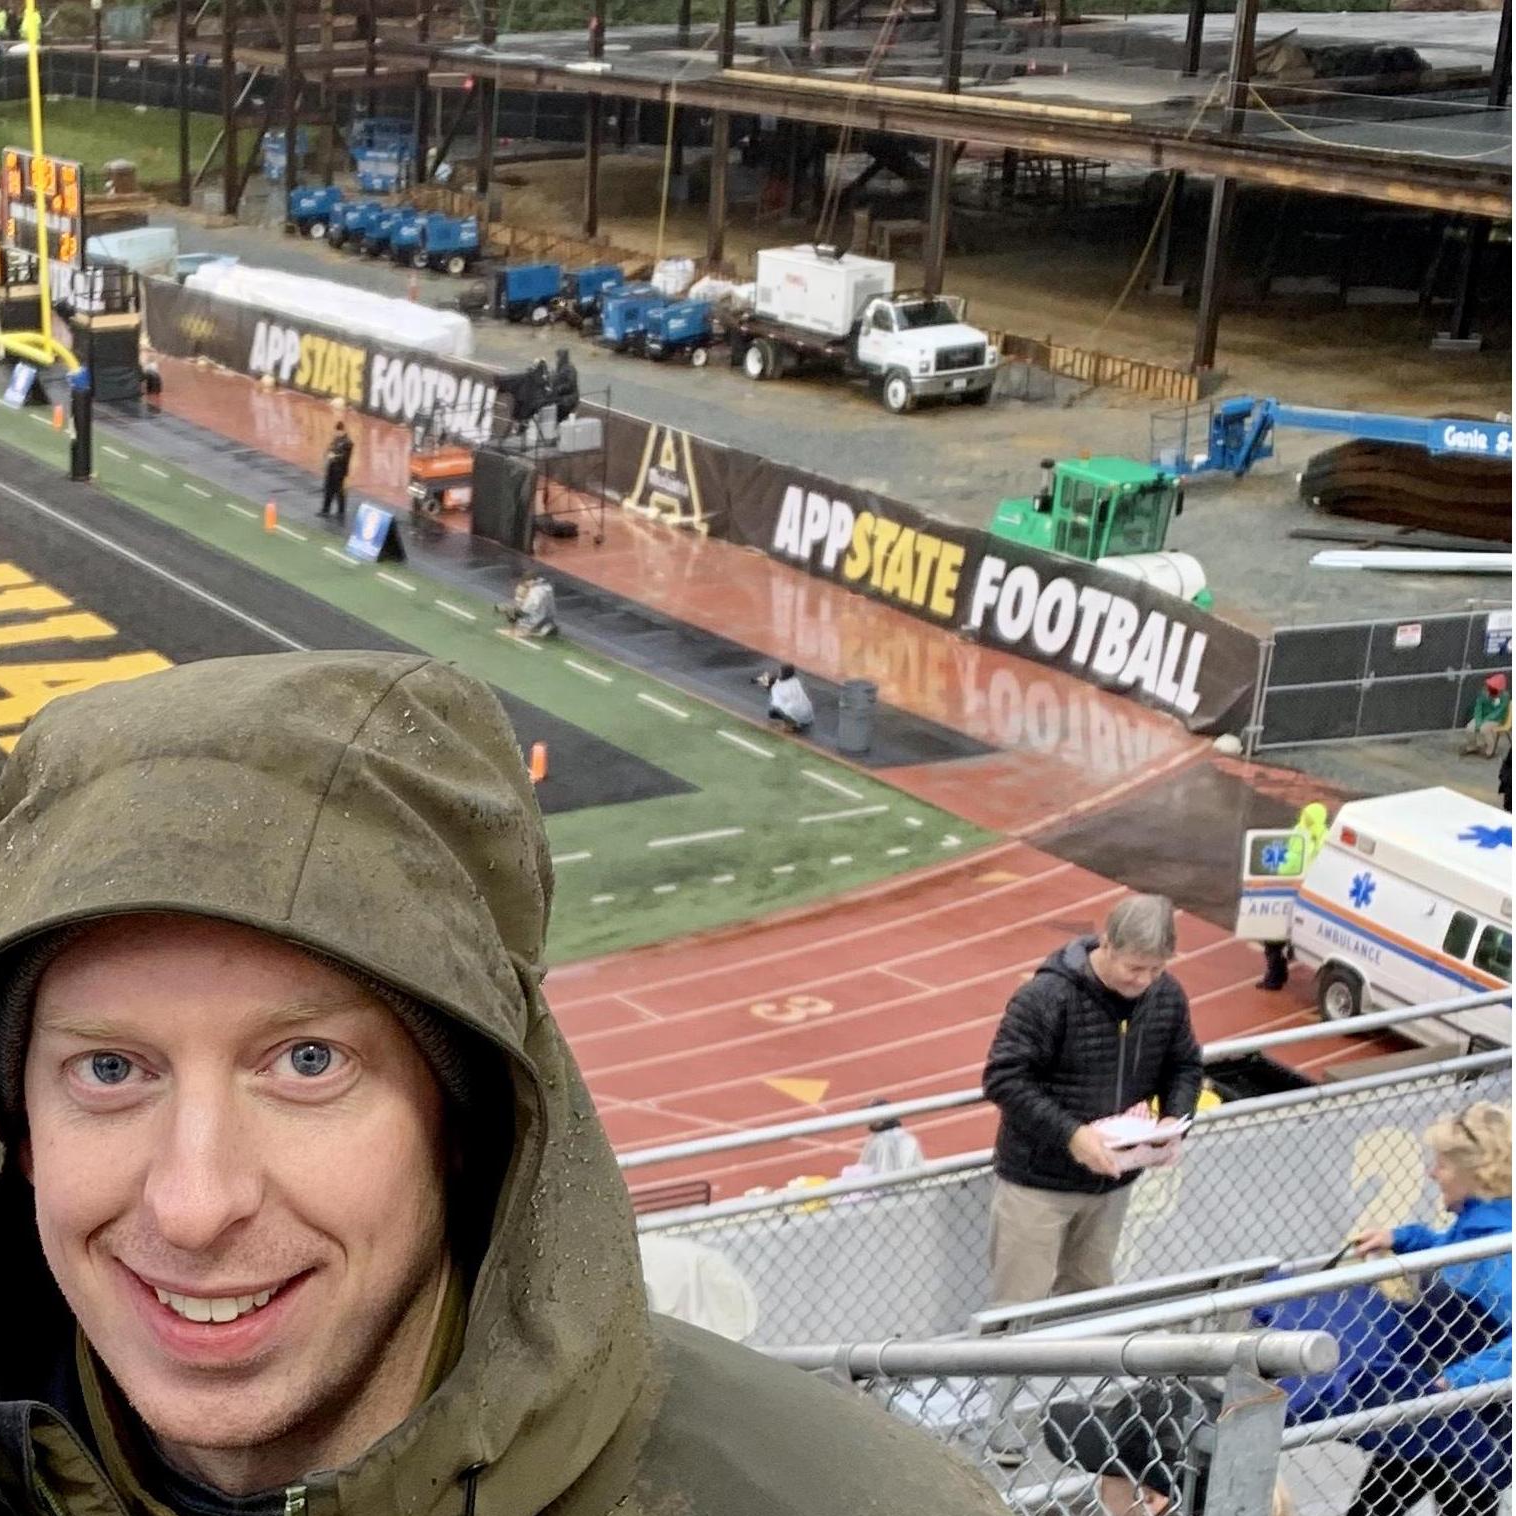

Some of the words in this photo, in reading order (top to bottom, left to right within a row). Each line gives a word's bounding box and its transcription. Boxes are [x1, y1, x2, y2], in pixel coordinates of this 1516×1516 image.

[1443, 424, 1488, 450] Genie
[968, 554, 1208, 716] FOOTBALL
[1316, 922, 1382, 966] AMBULANCE
